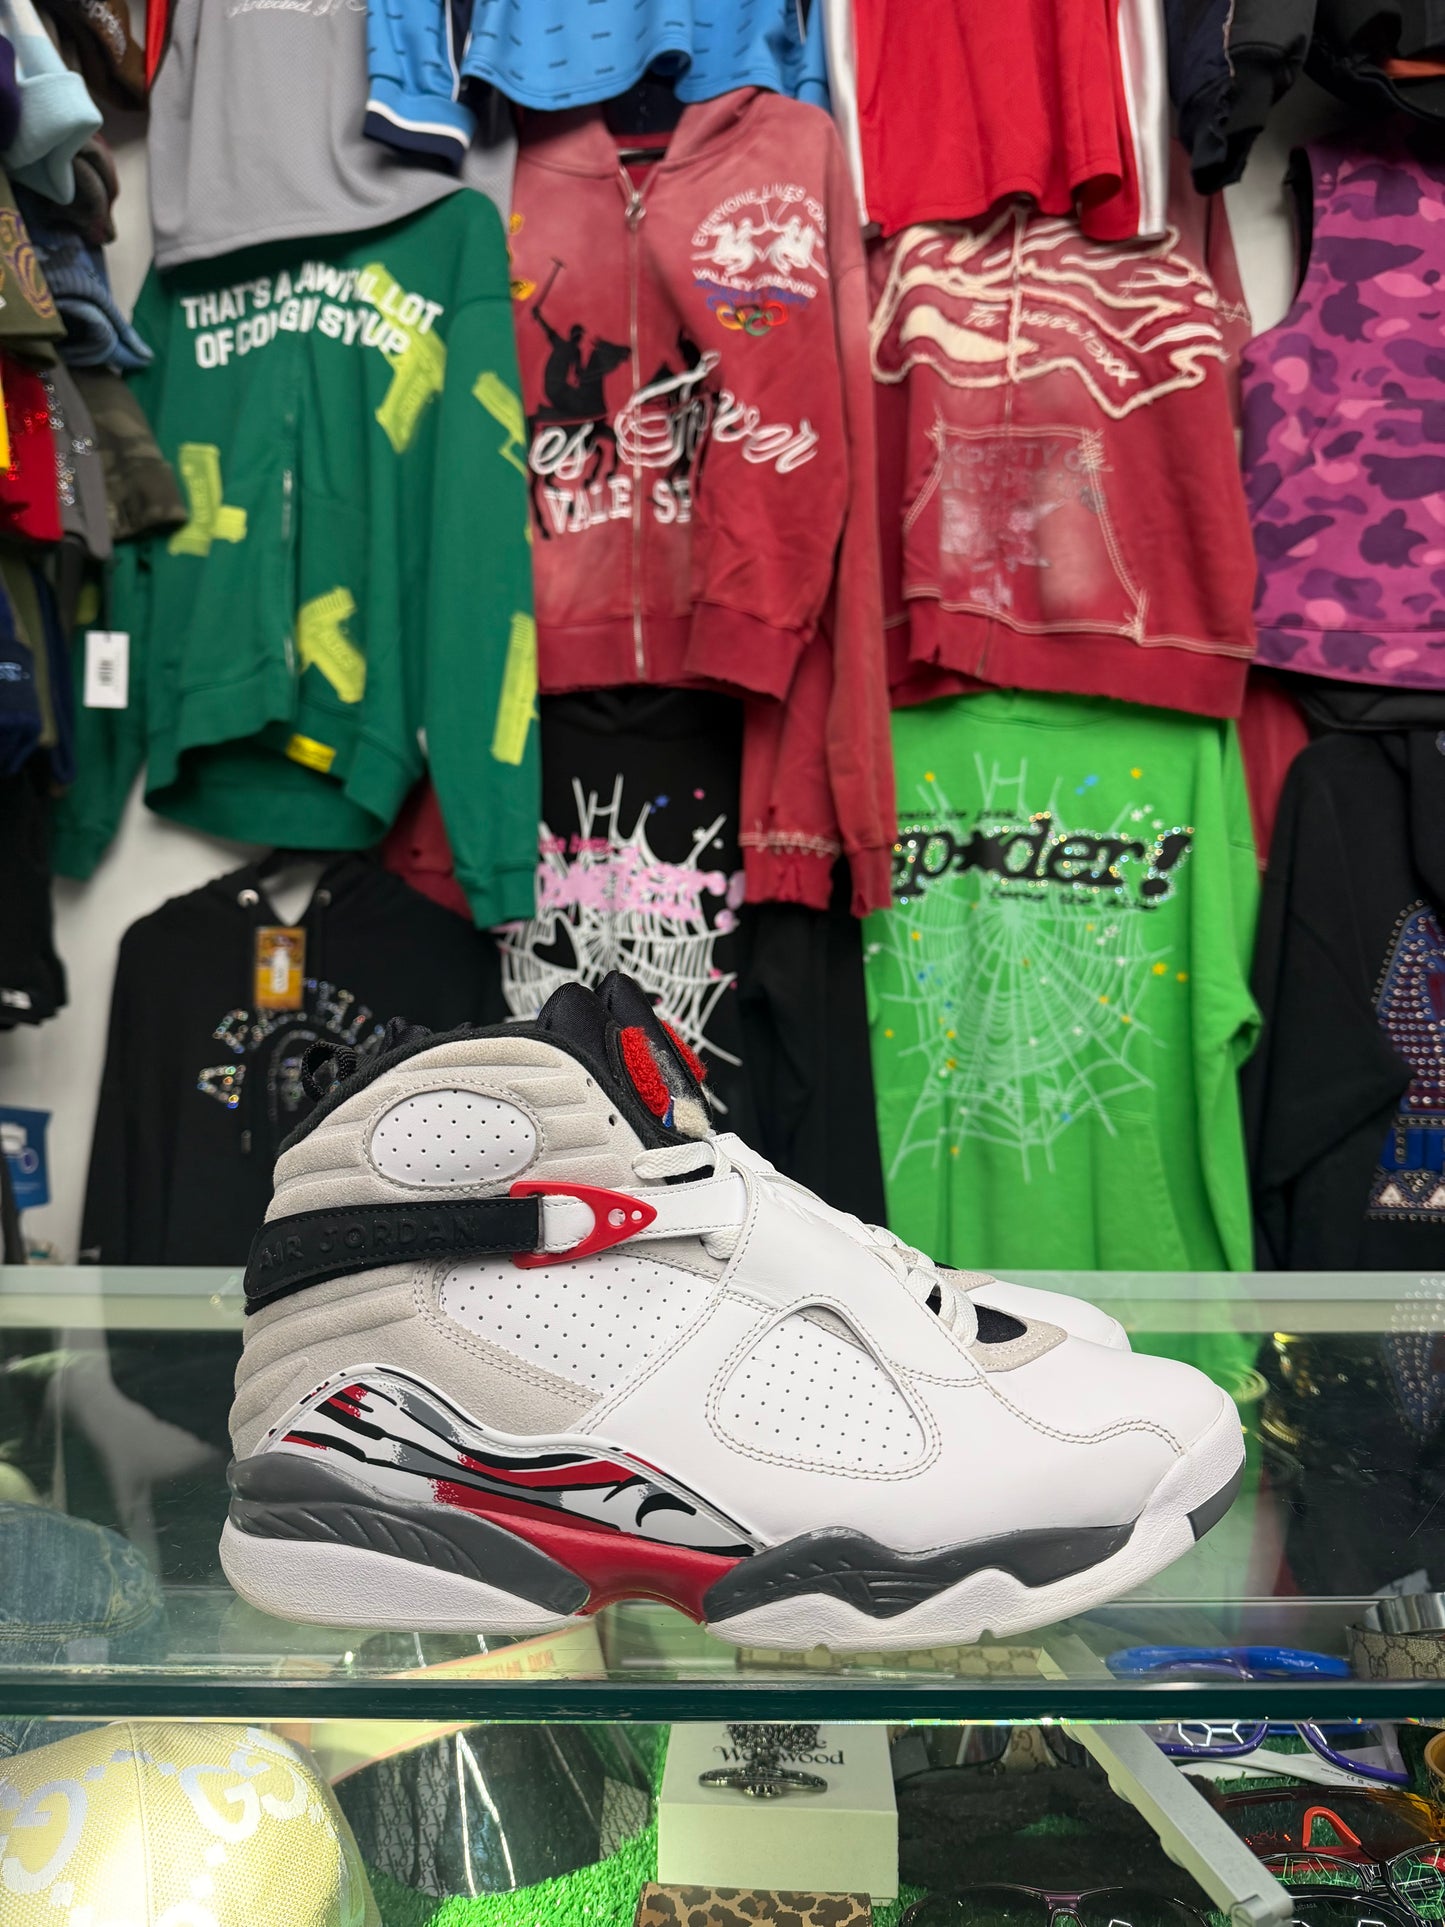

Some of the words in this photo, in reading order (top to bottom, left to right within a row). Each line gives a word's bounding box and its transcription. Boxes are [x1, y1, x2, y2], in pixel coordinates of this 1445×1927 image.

[274, 270, 292, 303] A
[382, 286, 444, 334] LOT
[195, 327, 234, 368] OF
[259, 1233, 304, 1272] AIR
[319, 1213, 479, 1252] JORDAN
